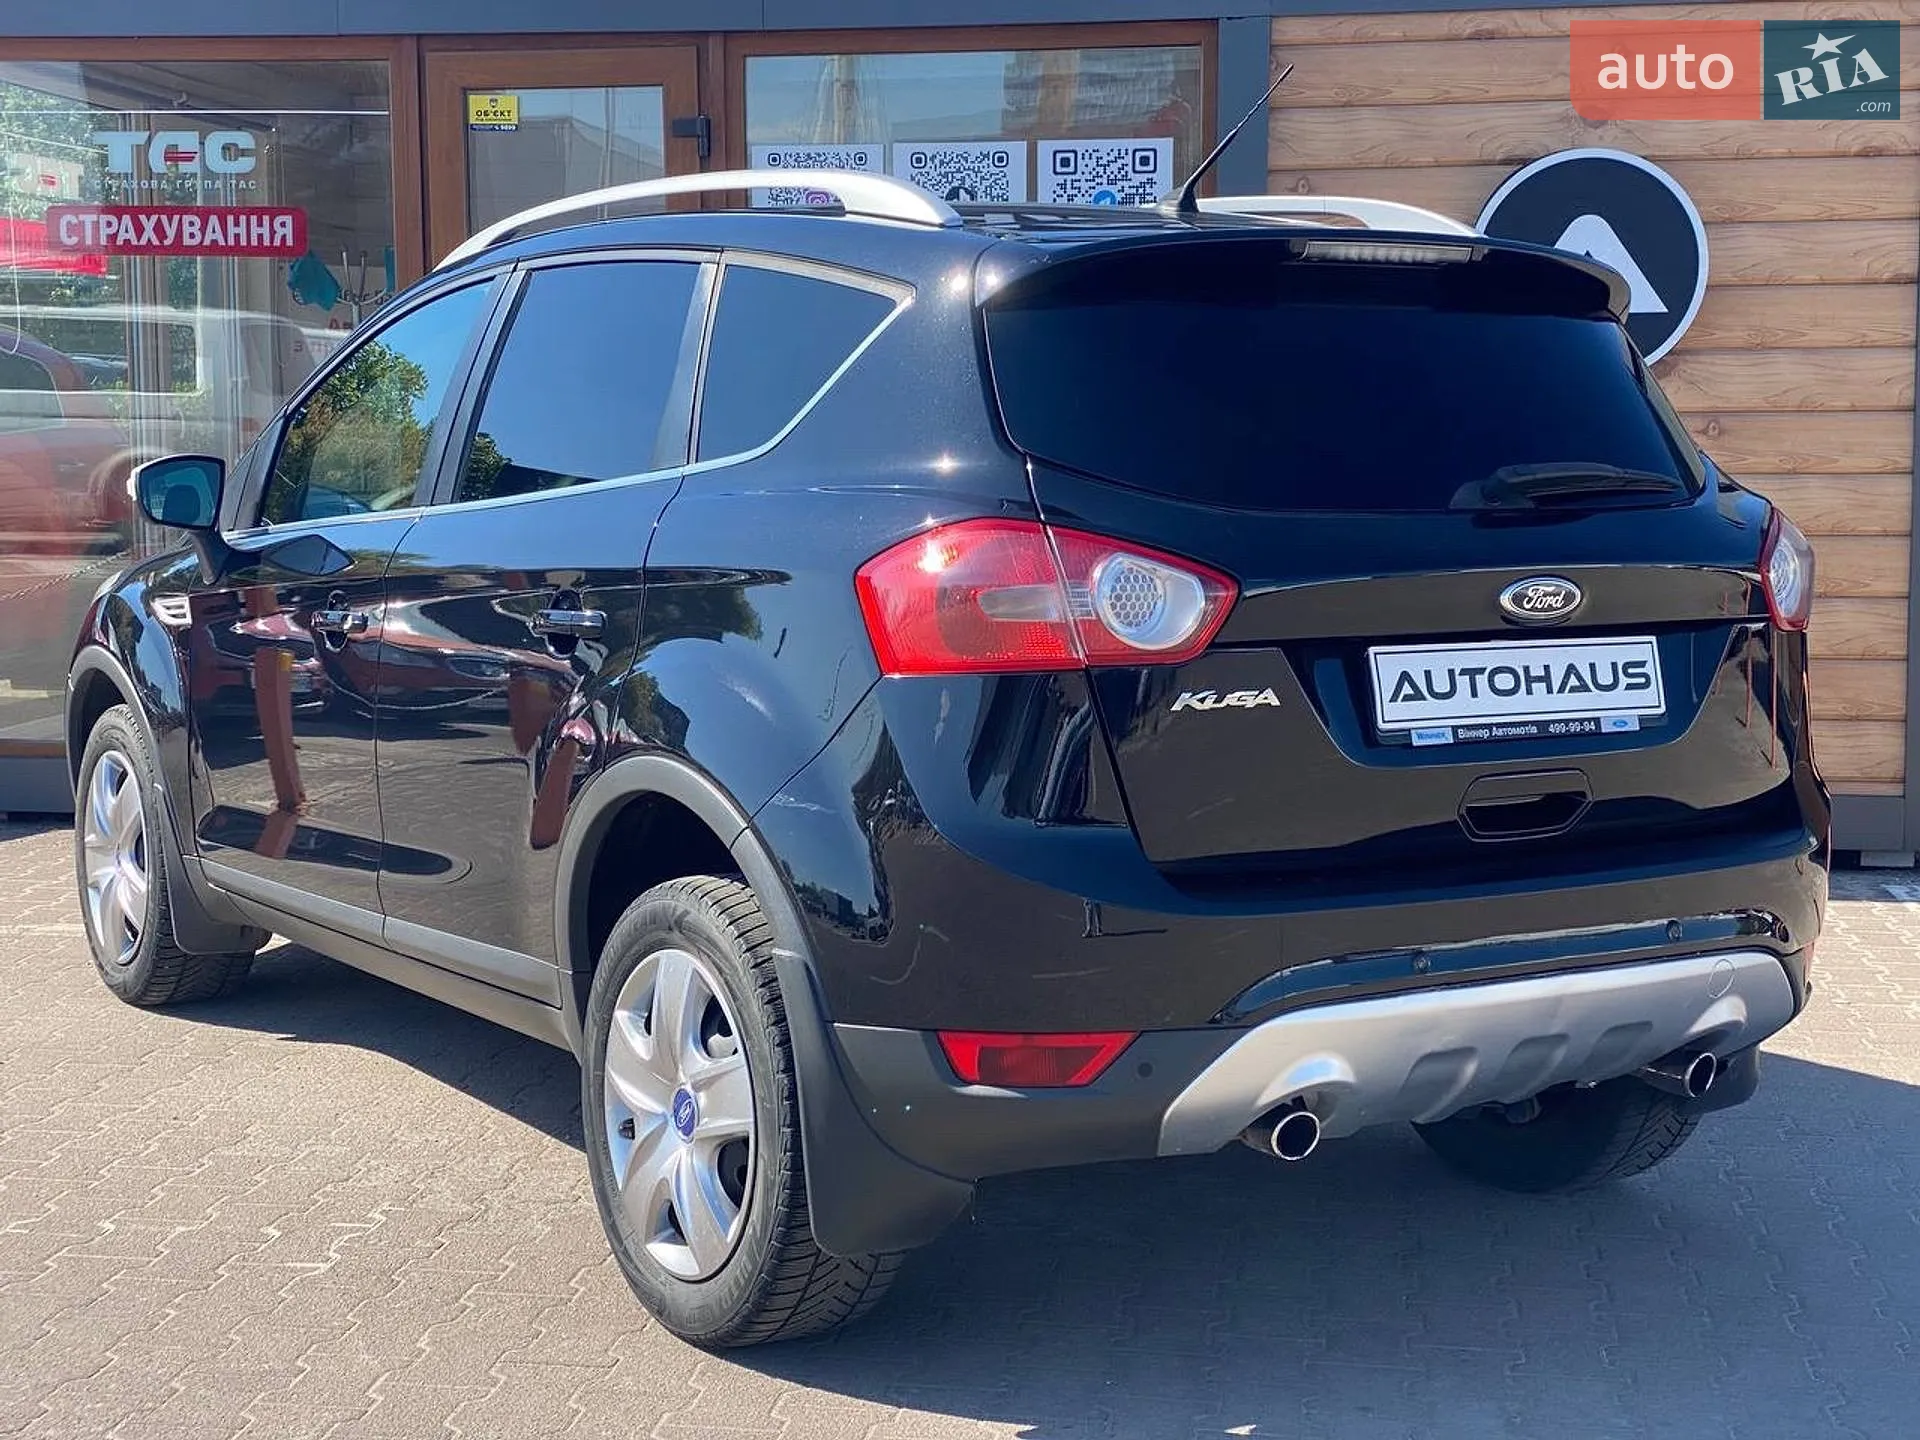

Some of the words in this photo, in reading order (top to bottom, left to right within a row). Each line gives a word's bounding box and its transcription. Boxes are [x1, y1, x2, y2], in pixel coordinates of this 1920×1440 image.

[59, 214, 294, 247] СТРАХУВАННЯ
[1523, 586, 1566, 609] Ford
[1388, 660, 1652, 703] AUTOHAUS
[1170, 687, 1281, 711] KUGA
[1547, 720, 1596, 734] 499-99-94
